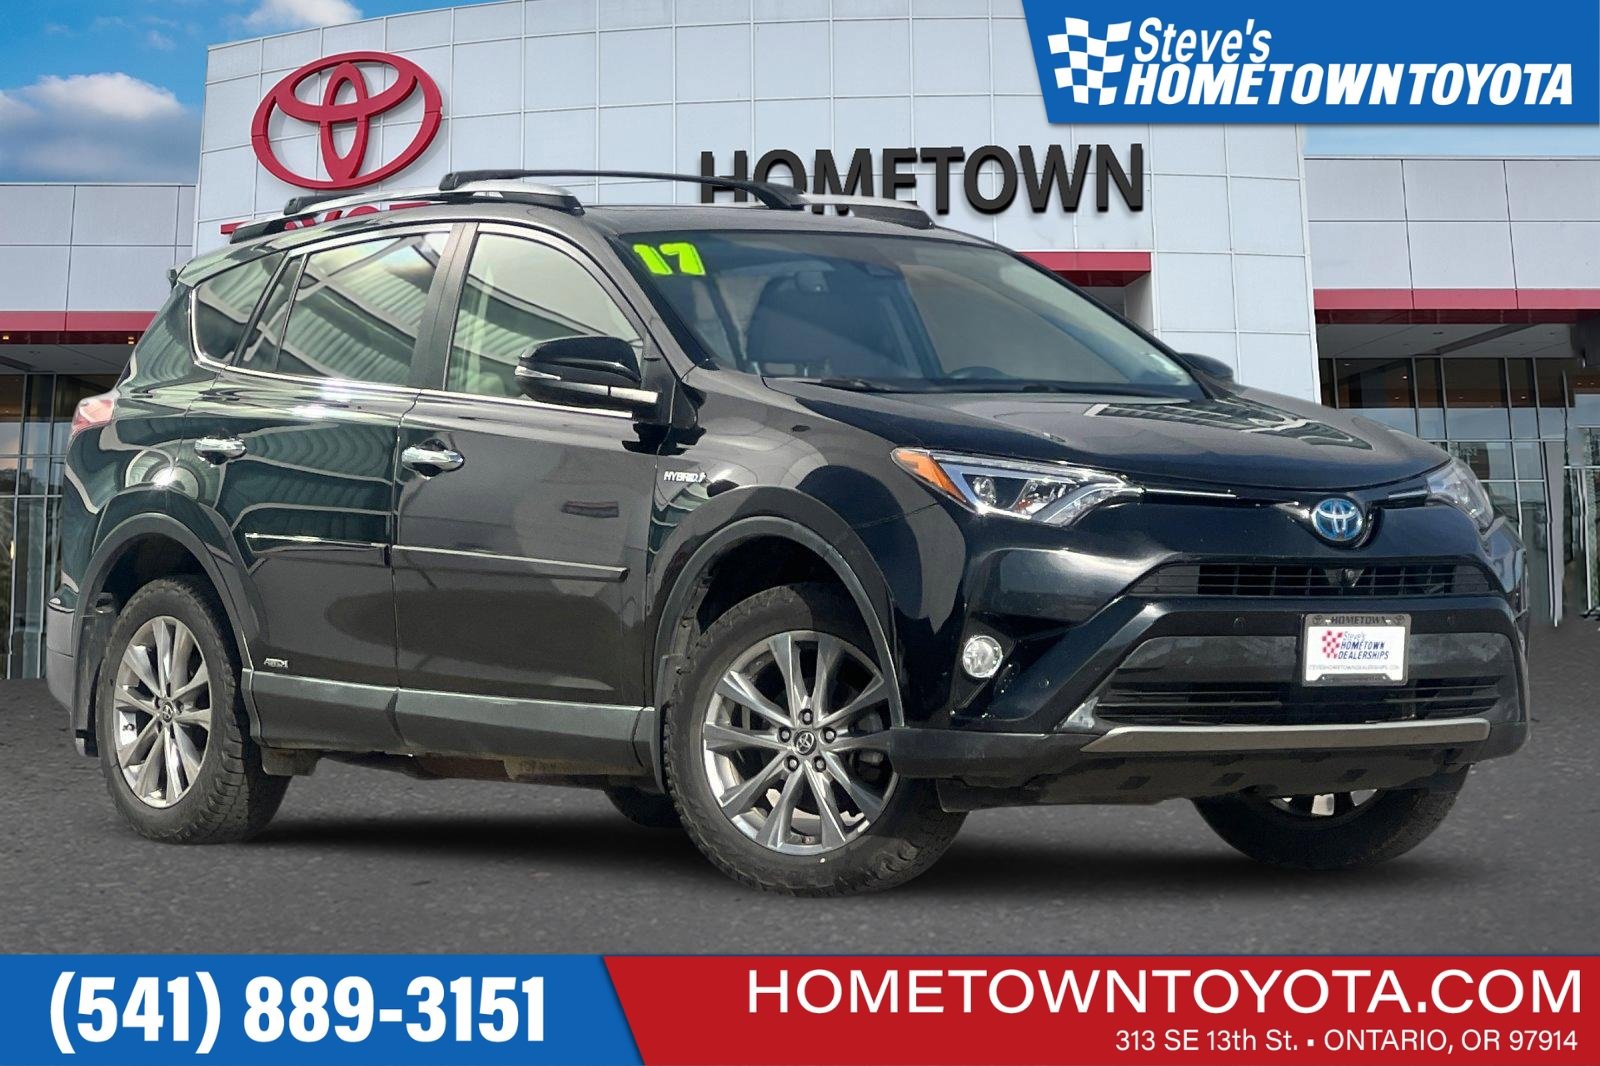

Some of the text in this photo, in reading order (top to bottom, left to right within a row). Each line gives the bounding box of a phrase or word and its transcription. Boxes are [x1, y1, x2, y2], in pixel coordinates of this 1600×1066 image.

[700, 143, 1145, 215] HOMETOWN
[633, 242, 705, 276] 17
[663, 471, 699, 483] HYBRID
[1340, 641, 1385, 651] HOMETOWN
[1338, 650, 1390, 660] DEALERSHIPS
